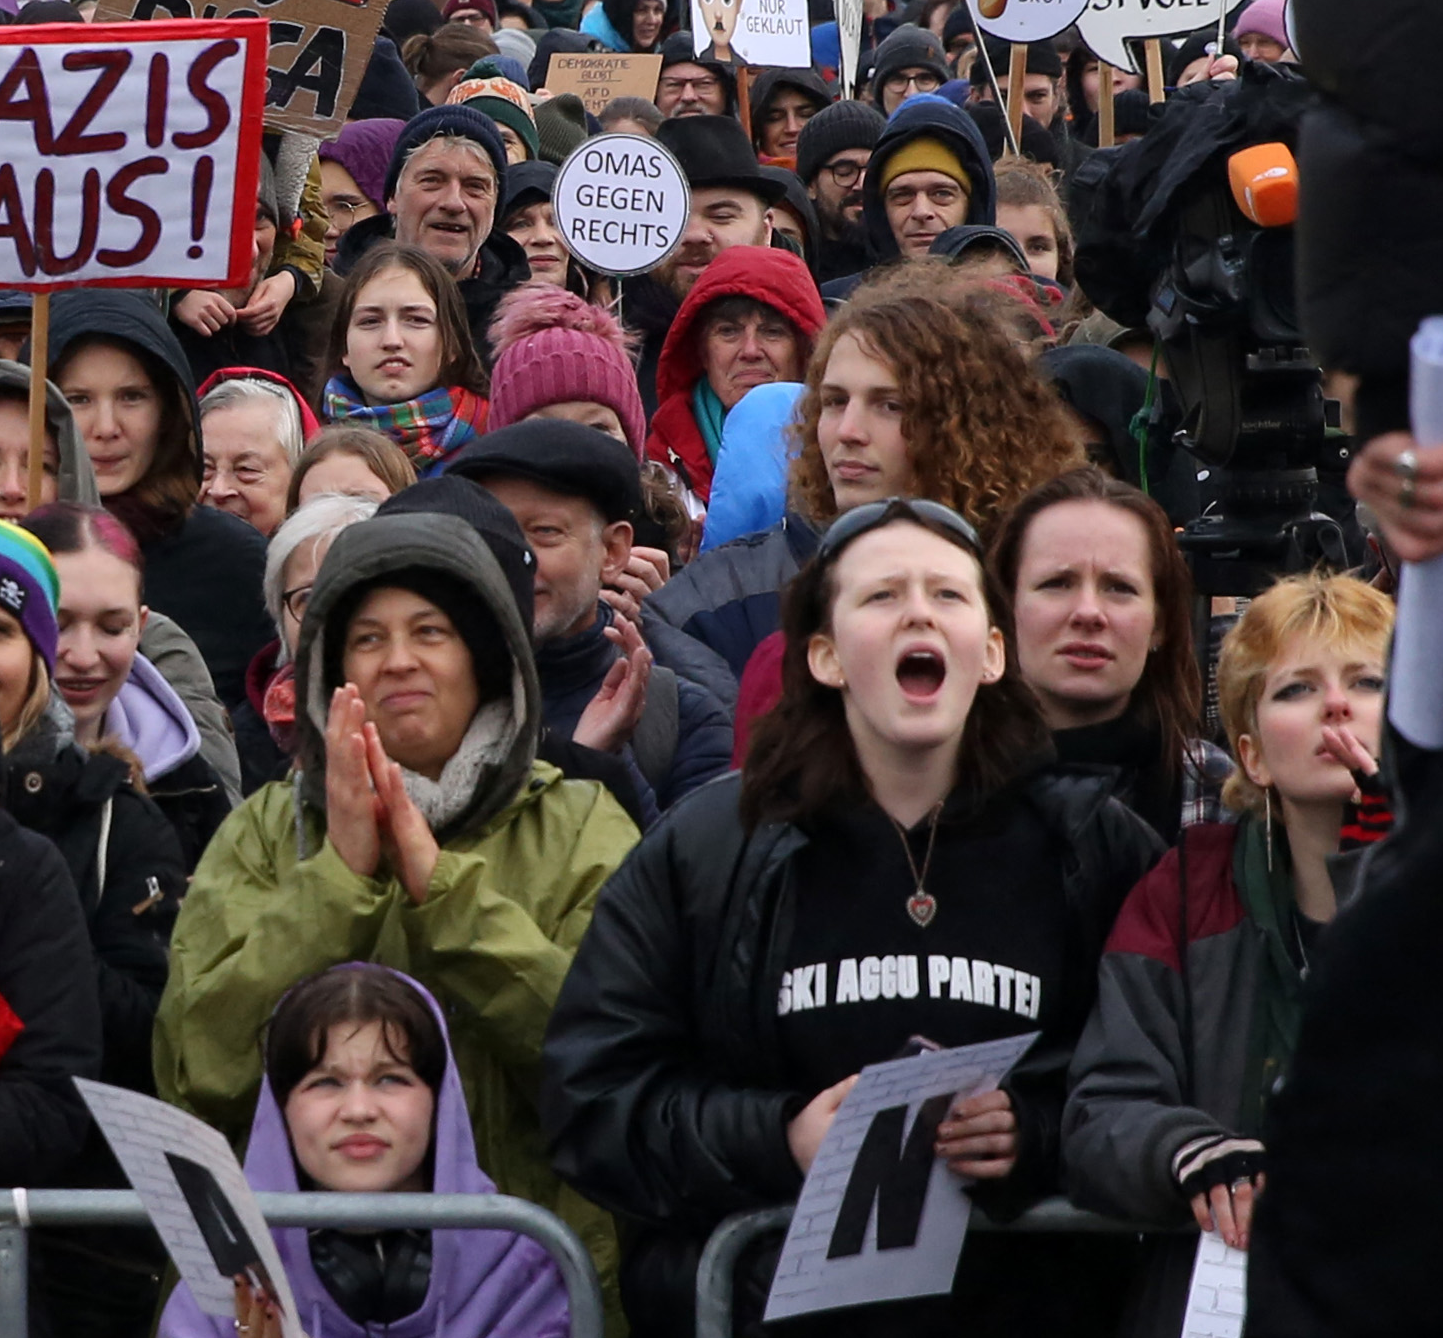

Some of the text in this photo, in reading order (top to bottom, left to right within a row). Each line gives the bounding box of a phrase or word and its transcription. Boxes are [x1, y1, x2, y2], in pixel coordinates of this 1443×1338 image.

[759, 0, 786, 15] NUR
[746, 16, 803, 35] GEKLAUT
[584, 150, 662, 179] OMAS
[576, 184, 664, 213] GEGEN
[571, 218, 669, 248] RECHTS
[777, 954, 1042, 1020] SKI AGGU PARTEI
[826, 1092, 957, 1260] N
